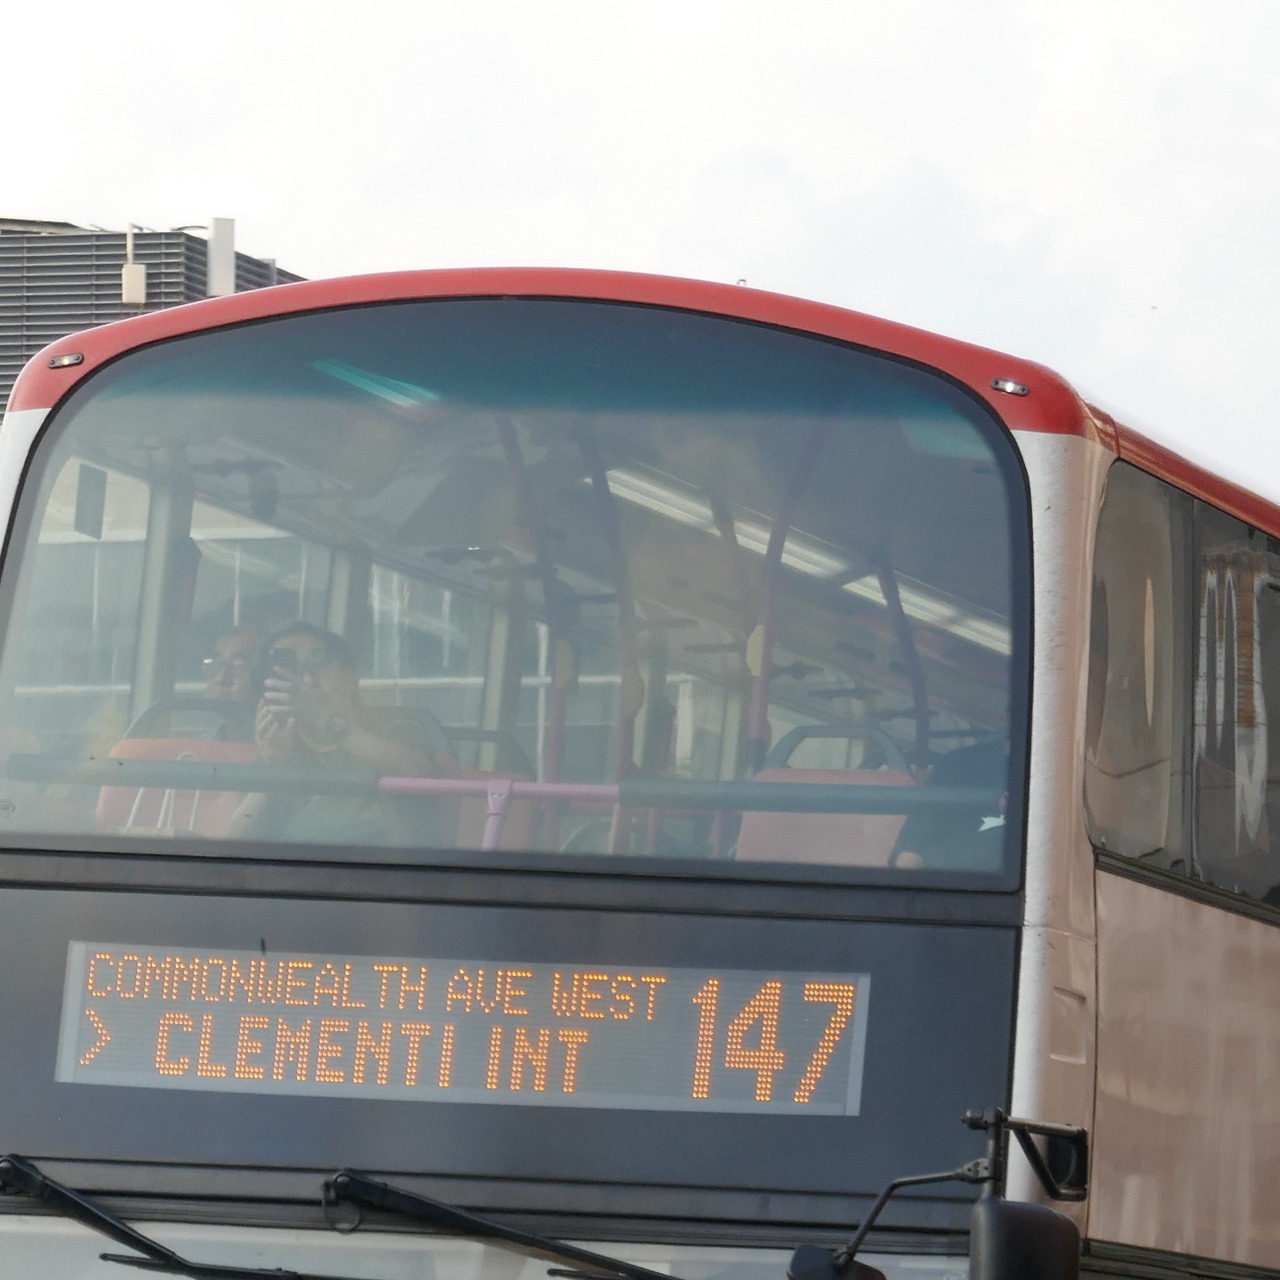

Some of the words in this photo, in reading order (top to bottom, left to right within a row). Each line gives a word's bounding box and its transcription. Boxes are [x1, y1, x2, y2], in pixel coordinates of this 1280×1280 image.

[87, 953, 428, 1009] COMMONWEALTH
[447, 968, 533, 1015] AVE
[552, 973, 668, 1020] WEST
[155, 1013, 455, 1089] CLEMENTI
[486, 1026, 589, 1093] INT
[692, 978, 855, 1103] 147
